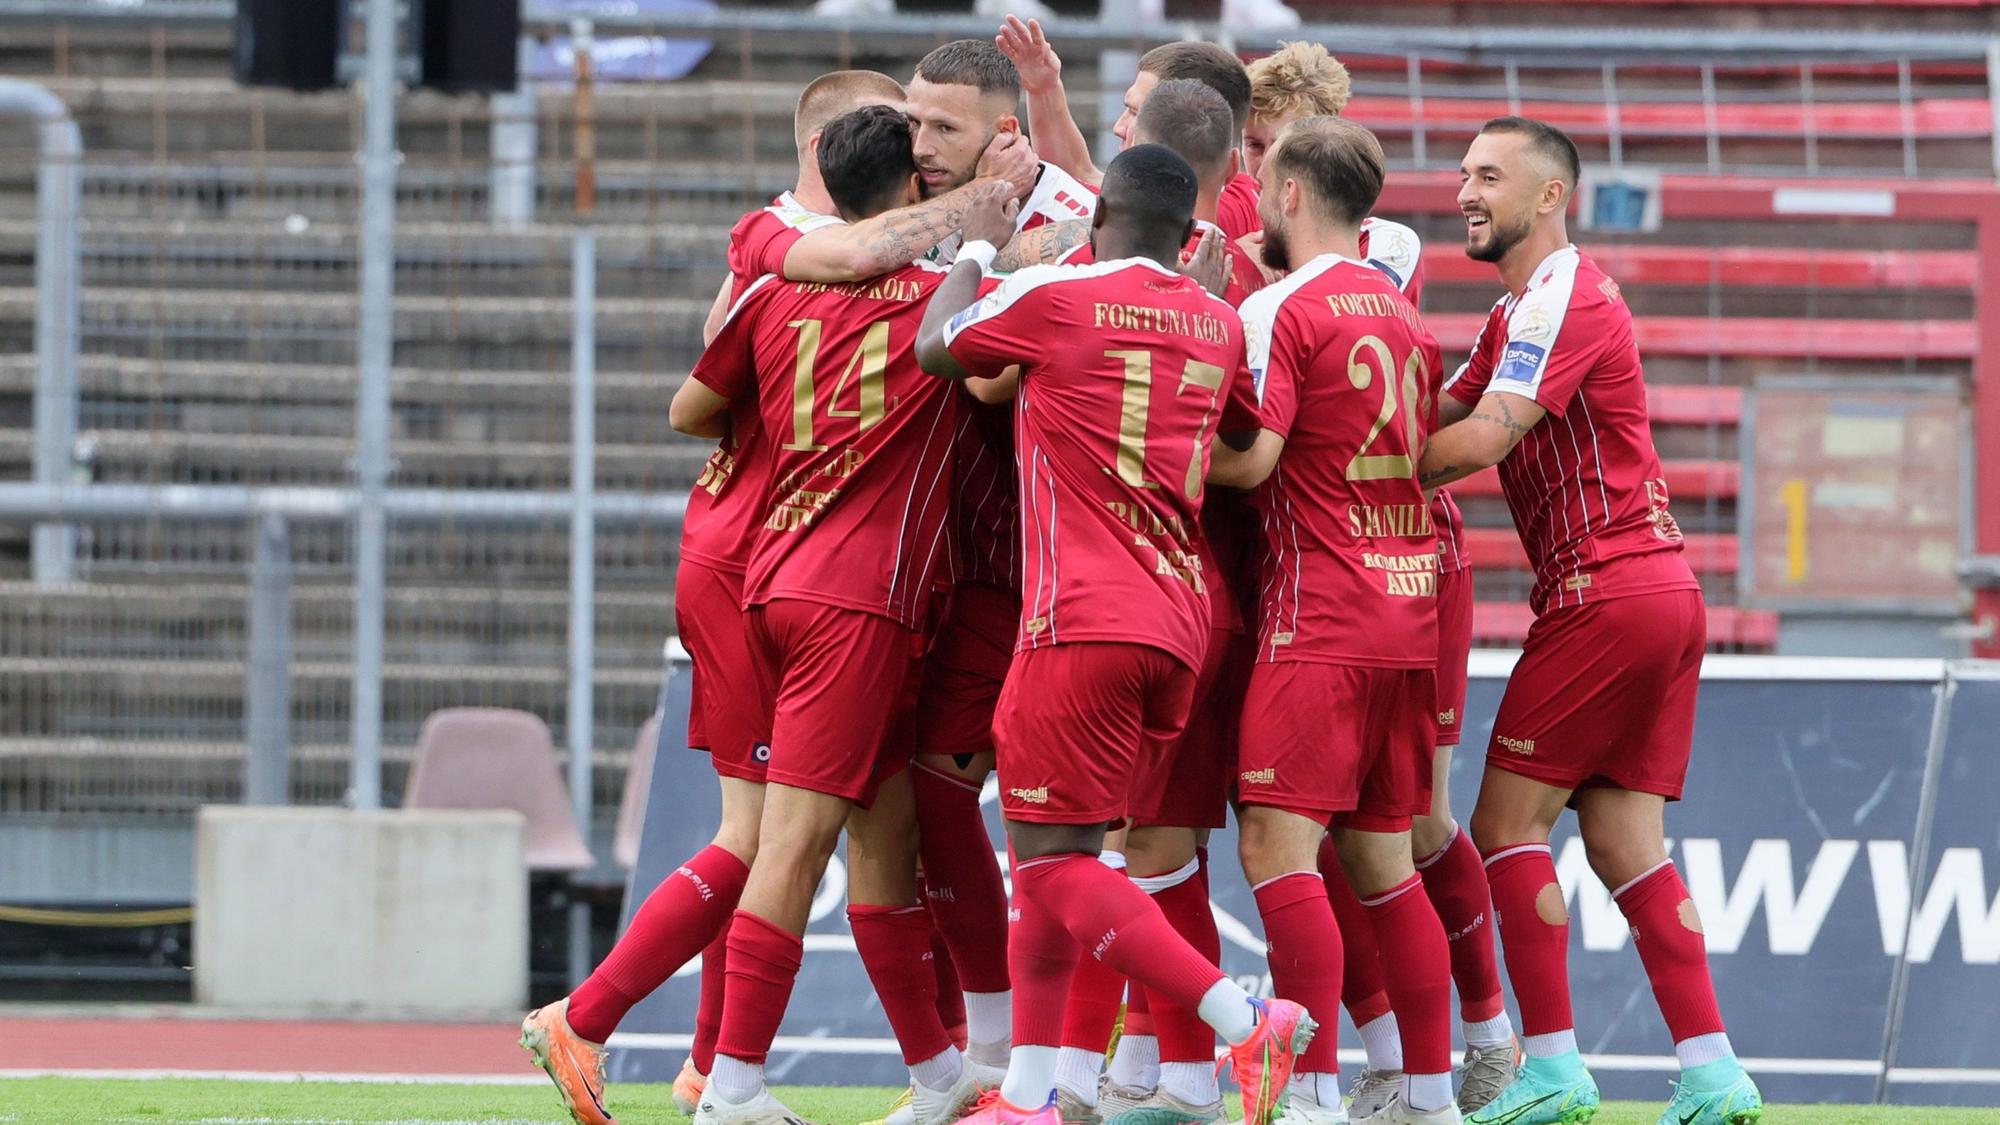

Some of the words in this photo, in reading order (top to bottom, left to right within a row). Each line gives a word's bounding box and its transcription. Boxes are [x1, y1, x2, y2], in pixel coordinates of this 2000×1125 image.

[1094, 302, 1190, 337] FORTUNA
[1192, 312, 1229, 345] KÖLN
[782, 318, 890, 452] 14
[1103, 350, 1225, 499] 17
[1346, 335, 1432, 481] 20
[1497, 735, 1535, 752] capelli
[1011, 787, 1048, 801] capelli
[1241, 768, 1276, 781] capelli
